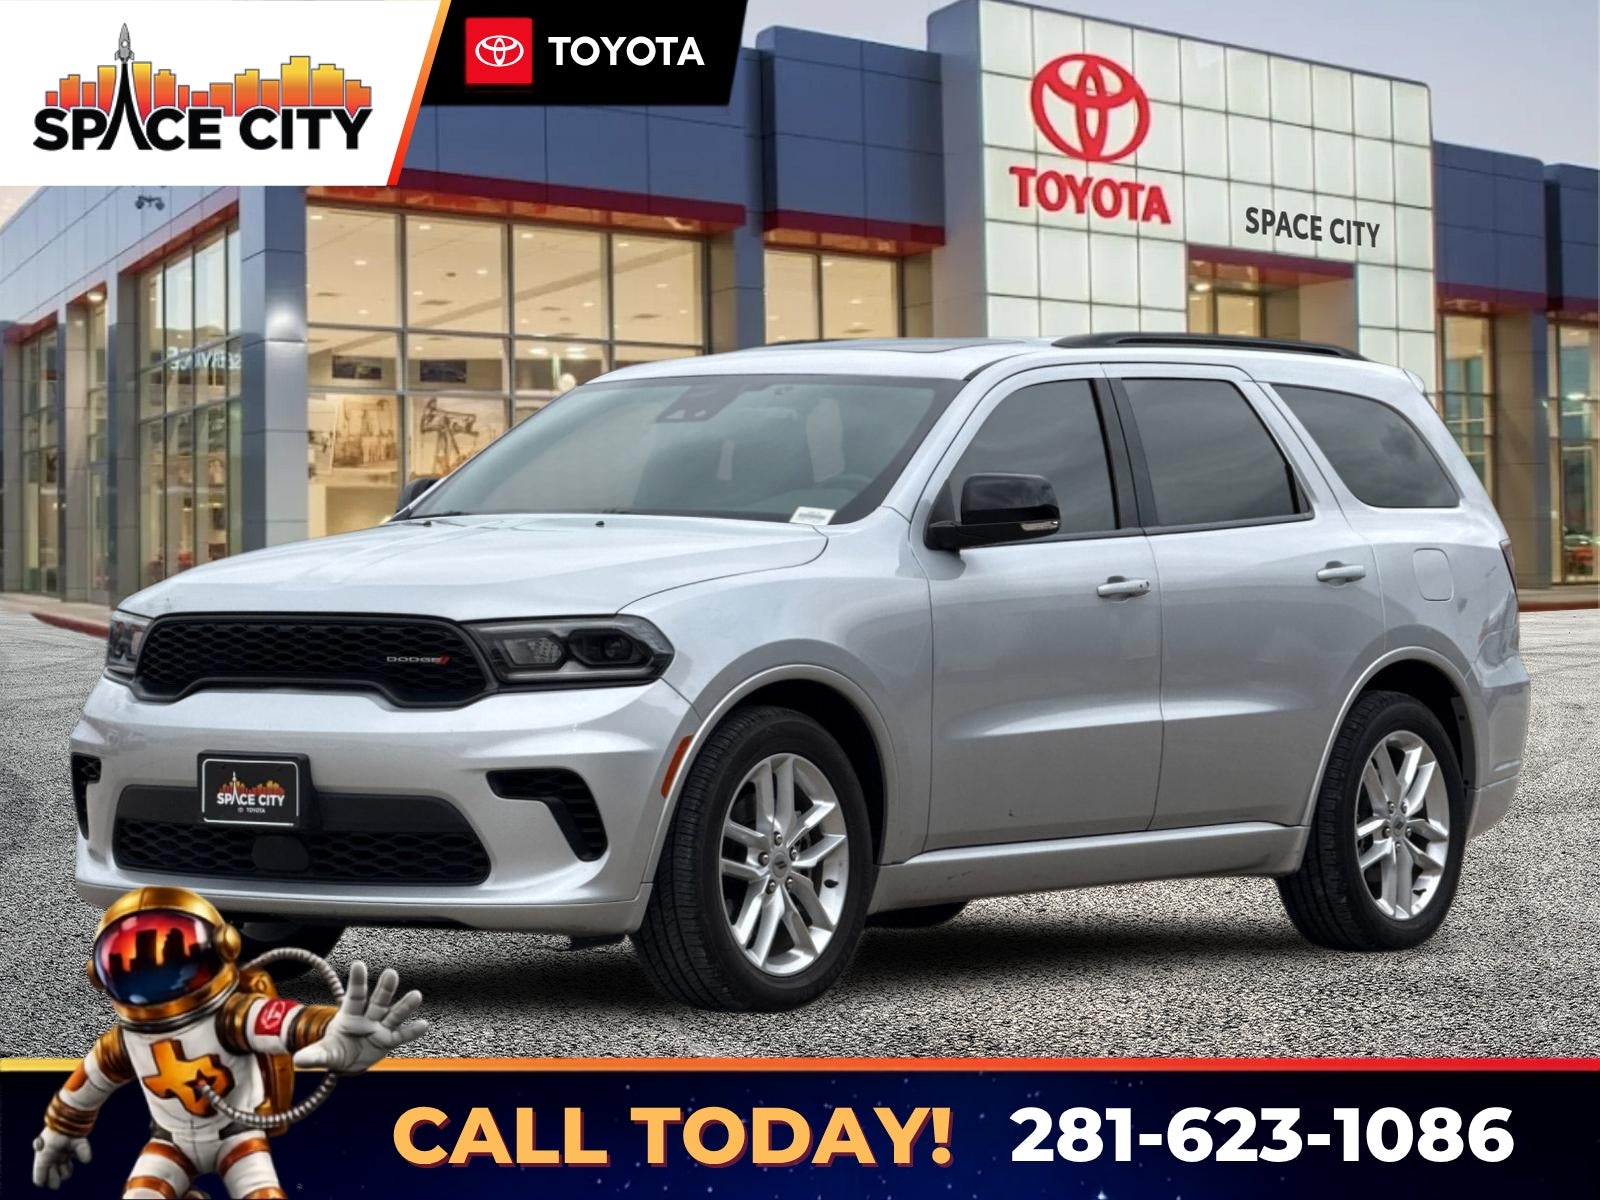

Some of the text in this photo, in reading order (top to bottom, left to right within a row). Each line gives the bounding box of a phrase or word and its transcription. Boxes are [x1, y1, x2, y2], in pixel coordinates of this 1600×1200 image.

[1008, 166, 1172, 225] TOYOTA
[1245, 206, 1381, 249] SPACE CITY
[386, 656, 443, 664] DODGE
[216, 790, 285, 807] SPACE CITY
